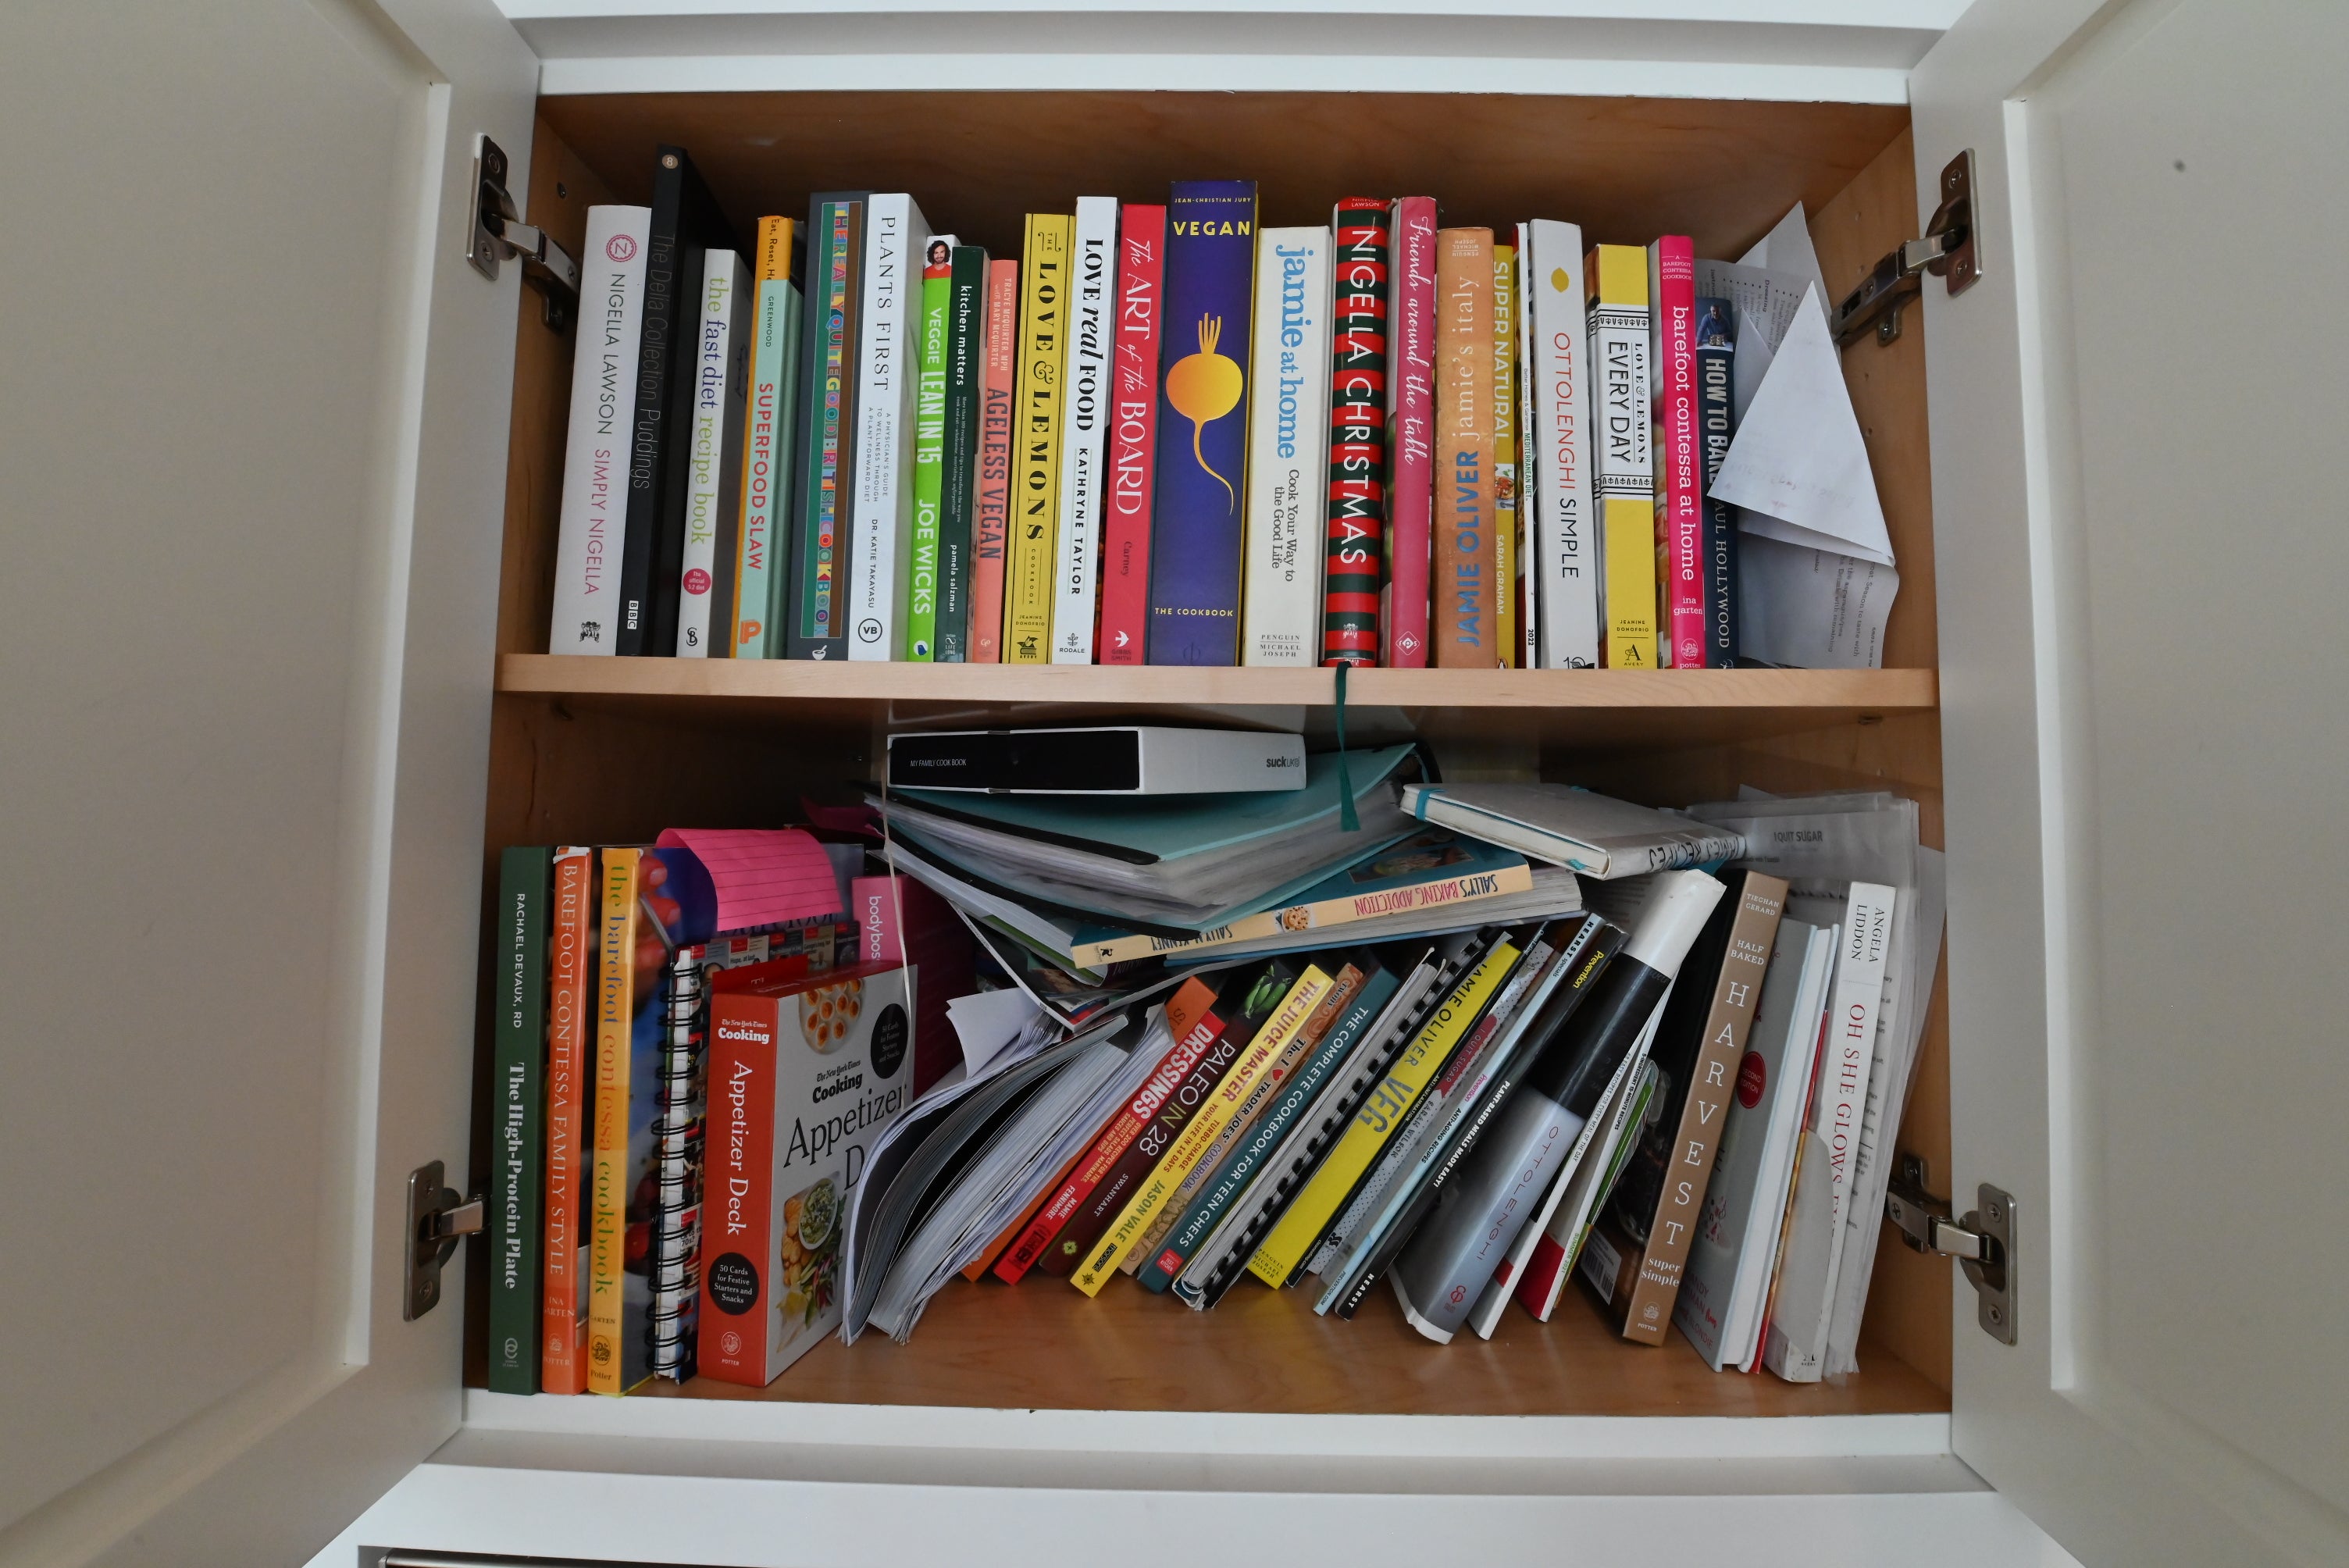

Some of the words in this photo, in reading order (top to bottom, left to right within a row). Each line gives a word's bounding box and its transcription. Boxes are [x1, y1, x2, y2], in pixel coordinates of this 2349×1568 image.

[651, 234, 675, 263] The
[1126, 237, 1153, 266] The
[1173, 221, 1250, 236] VEGAN
[1409, 216, 1432, 291] friends
[877, 217, 896, 308] PLANTS
[1083, 238, 1103, 300] LOVE
[606, 274, 626, 346] NIGELLA
[647, 269, 672, 310] Delia
[708, 277, 729, 312] the
[958, 285, 972, 332] kitchen
[1125, 273, 1152, 340] ART
[1276, 244, 1314, 347] jamie
[1347, 230, 1377, 362] NIGELLA
[1453, 276, 1479, 333] italy
[1494, 262, 1509, 333] SUPER
[704, 319, 726, 361] fast
[765, 296, 774, 347] GREENWOOD
[928, 308, 942, 364] VEGGIE
[1081, 308, 1104, 359] real
[1406, 298, 1429, 367] around
[641, 317, 668, 401] Collection
[874, 323, 891, 390] FIRST
[957, 337, 967, 385] matters
[1117, 344, 1142, 362] of
[1281, 352, 1299, 373] at
[1674, 306, 1691, 390] barefoot
[597, 354, 619, 434] LAWSON
[700, 366, 723, 409] diet
[918, 372, 944, 415] LEAN
[1077, 364, 1096, 430] FOOD
[1121, 365, 1148, 394] the
[1406, 372, 1429, 411] the
[1452, 346, 1480, 441] jamie's
[1493, 341, 1510, 444] NATURAL
[1608, 341, 1629, 410] EVERY
[1706, 358, 1727, 403] HOW
[918, 420, 943, 439] IN
[982, 387, 1009, 479] AGELESS
[1277, 376, 1304, 459] home
[1553, 332, 1576, 489] OTTOLENGHI
[1707, 406, 1728, 430] TO
[629, 408, 661, 489] Puddings
[692, 416, 718, 484] recipe
[751, 383, 773, 508] SUPERFOOD
[917, 447, 941, 464] 15
[1116, 401, 1146, 515] BOARD
[1404, 414, 1428, 466] table
[1609, 416, 1631, 463] DAY
[1677, 396, 1691, 489] contessa
[591, 449, 610, 511] SIMPLY
[1075, 448, 1088, 528] KATHRYNE
[1289, 469, 1299, 501] Cook
[1340, 376, 1372, 564] CHRISTMAS
[691, 493, 715, 544] book
[917, 499, 935, 540] JOE
[1274, 486, 1285, 506] the
[1287, 506, 1298, 535] Your
[1456, 451, 1480, 553] OLIVER
[1680, 495, 1693, 516] at
[747, 516, 765, 569] SLAW
[979, 488, 1004, 559] VEGAN
[1273, 509, 1283, 541] Good
[1559, 498, 1579, 578] SIMPLE
[584, 519, 604, 595] NIGELLA
[1071, 537, 1083, 594] TAYLOR
[1271, 546, 1282, 568] Life
[1284, 539, 1297, 566] Way
[1285, 569, 1293, 582] to
[1681, 522, 1696, 581] home
[914, 545, 933, 615] WICKS
[1457, 564, 1481, 647] JAMIE
[1496, 571, 1505, 615] GRAHAM
[627, 600, 639, 629] BBC
[1674, 607, 1702, 615] garten
[610, 866, 628, 907] the
[1354, 888, 1415, 917] ADDICTION
[1420, 880, 1460, 907] BAKING
[1460, 873, 1499, 898] SALLY'S
[1745, 903, 1775, 916] GERARD
[1746, 893, 1780, 908] TIEGHAN
[516, 893, 526, 950] RACHAEL
[558, 864, 578, 984] BAREFOOT
[1737, 939, 1764, 953] HALF
[1850, 904, 1868, 961] LIDDON
[1869, 907, 1885, 963] ANGELA
[513, 954, 524, 1007] DEVAUX,
[604, 914, 626, 1023] barefoot
[1571, 950, 1604, 990] Prevention
[1731, 950, 1764, 965] BAKED
[1292, 979, 1319, 1009] THE
[1346, 1006, 1367, 1030] THE
[513, 1012, 522, 1028] RD
[718, 1027, 769, 1044] Cooking
[1263, 1006, 1299, 1048] JUICE
[1847, 1004, 1866, 1039] OH
[554, 989, 572, 1108] CONTESSA
[1129, 1022, 1214, 1121] DRESSINGS
[1175, 1039, 1236, 1107] PALEO
[1222, 1046, 1268, 1102] MASTER
[1299, 1029, 1349, 1090] COMPLETE
[1839, 1048, 1860, 1095] SHE
[508, 1062, 525, 1100] The
[600, 1034, 615, 1152] contessa
[812, 1071, 863, 1104] Cooking
[729, 1060, 753, 1171] Appetizer
[783, 1082, 908, 1169] Appetizer
[1160, 1102, 1186, 1128] IN
[1249, 1089, 1303, 1156] COOKBOOK
[1666, 982, 1749, 1245] HARVEST
[551, 1117, 569, 1198] FAMILY
[1137, 1124, 1169, 1158] 28
[1177, 1118, 1221, 1171] TURBO-CHARGE
[1830, 1103, 1852, 1184] GLOWS
[504, 1105, 524, 1236] High-Protein
[1231, 1155, 1252, 1180] FOR
[728, 1178, 749, 1236] Deck
[1046, 1185, 1075, 1219] FENNIMORE
[1058, 1197, 1076, 1217] MAMIE
[1092, 1173, 1129, 1217] SWANHART
[1132, 1180, 1167, 1218] JASON
[1207, 1179, 1233, 1210] TEEN
[1477, 1126, 1559, 1261] OTTOLENGHI
[551, 1206, 565, 1275] STYLE
[595, 1161, 615, 1294] cookbook
[1114, 1214, 1139, 1242] VALE
[1178, 1209, 1210, 1247] CHEFS
[505, 1238, 521, 1289] Plate
[730, 1266, 748, 1276] Cards
[1641, 1270, 1680, 1287] simple
[1648, 1257, 1681, 1273] super
[722, 1293, 744, 1304] Snacks
[1347, 1273, 1374, 1308] HEARST
